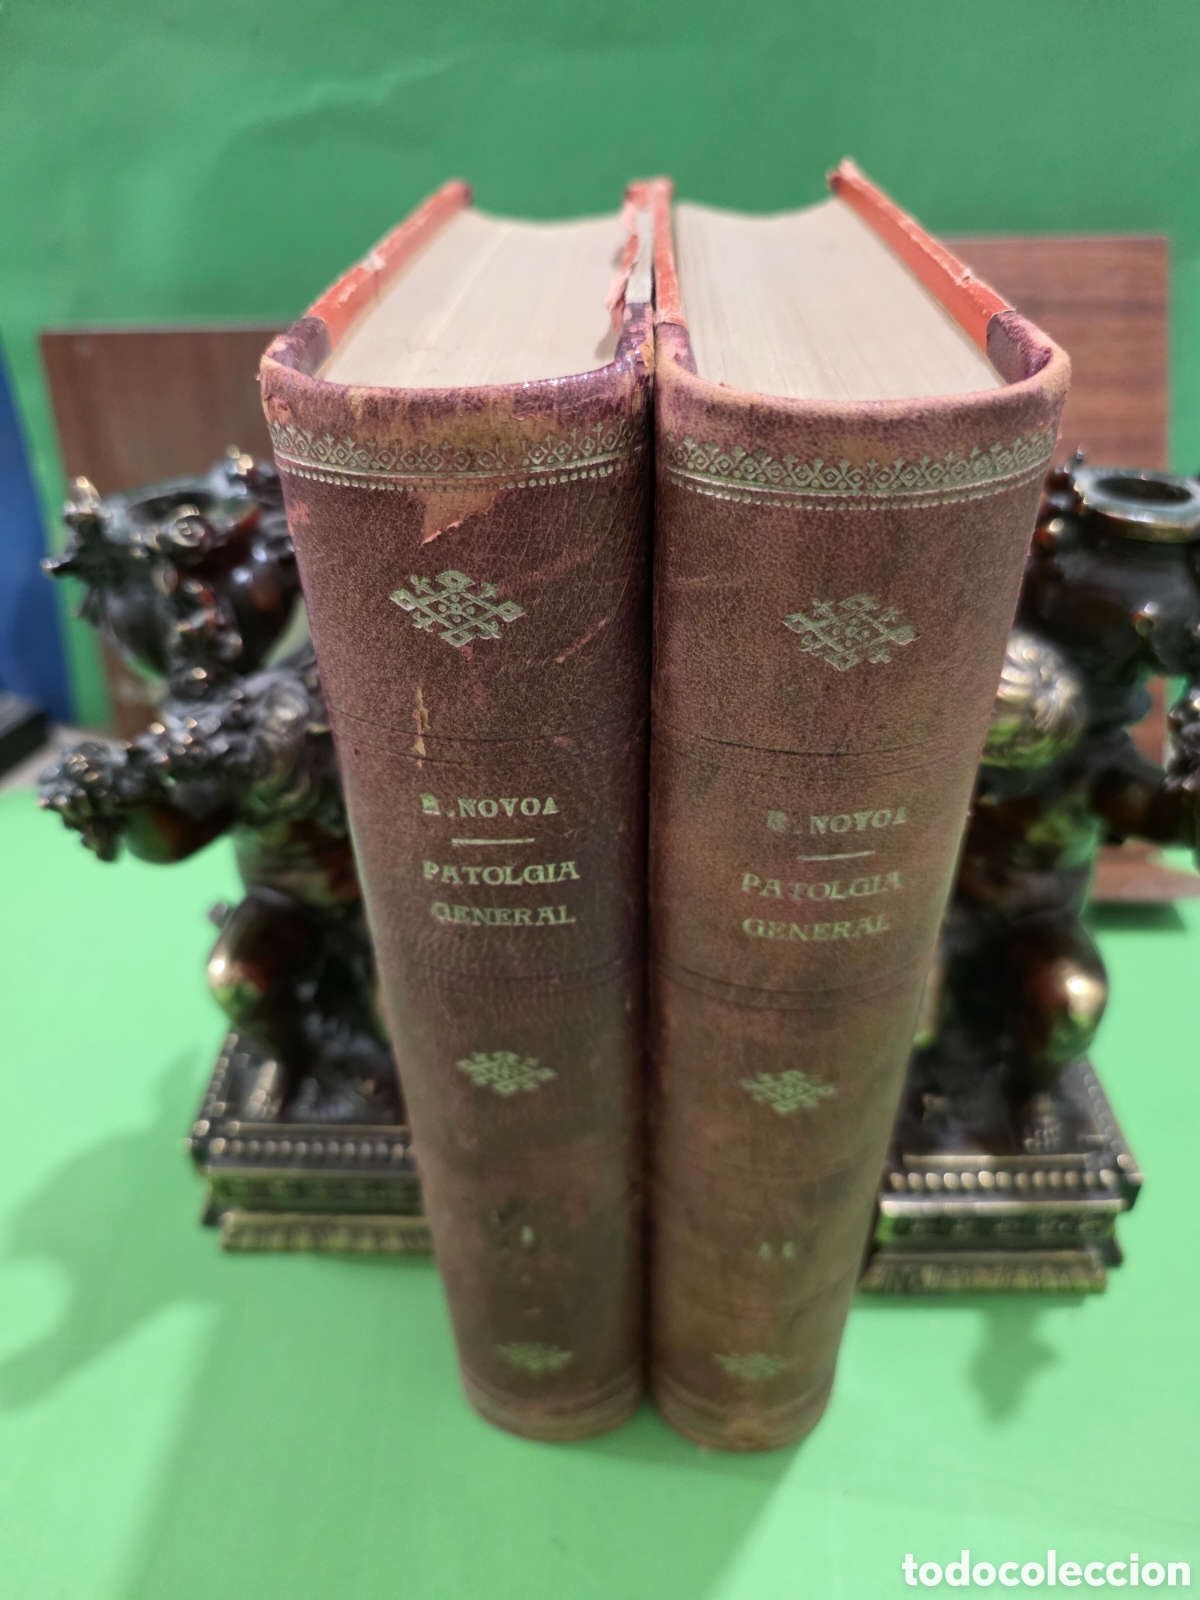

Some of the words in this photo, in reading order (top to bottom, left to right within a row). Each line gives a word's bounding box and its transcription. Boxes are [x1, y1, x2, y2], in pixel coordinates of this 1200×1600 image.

[422, 860, 581, 885] PATOLGIA
[740, 871, 902, 900] PATOLGIA
[430, 901, 577, 926] GENERAL
[742, 914, 890, 942] GENERAL
